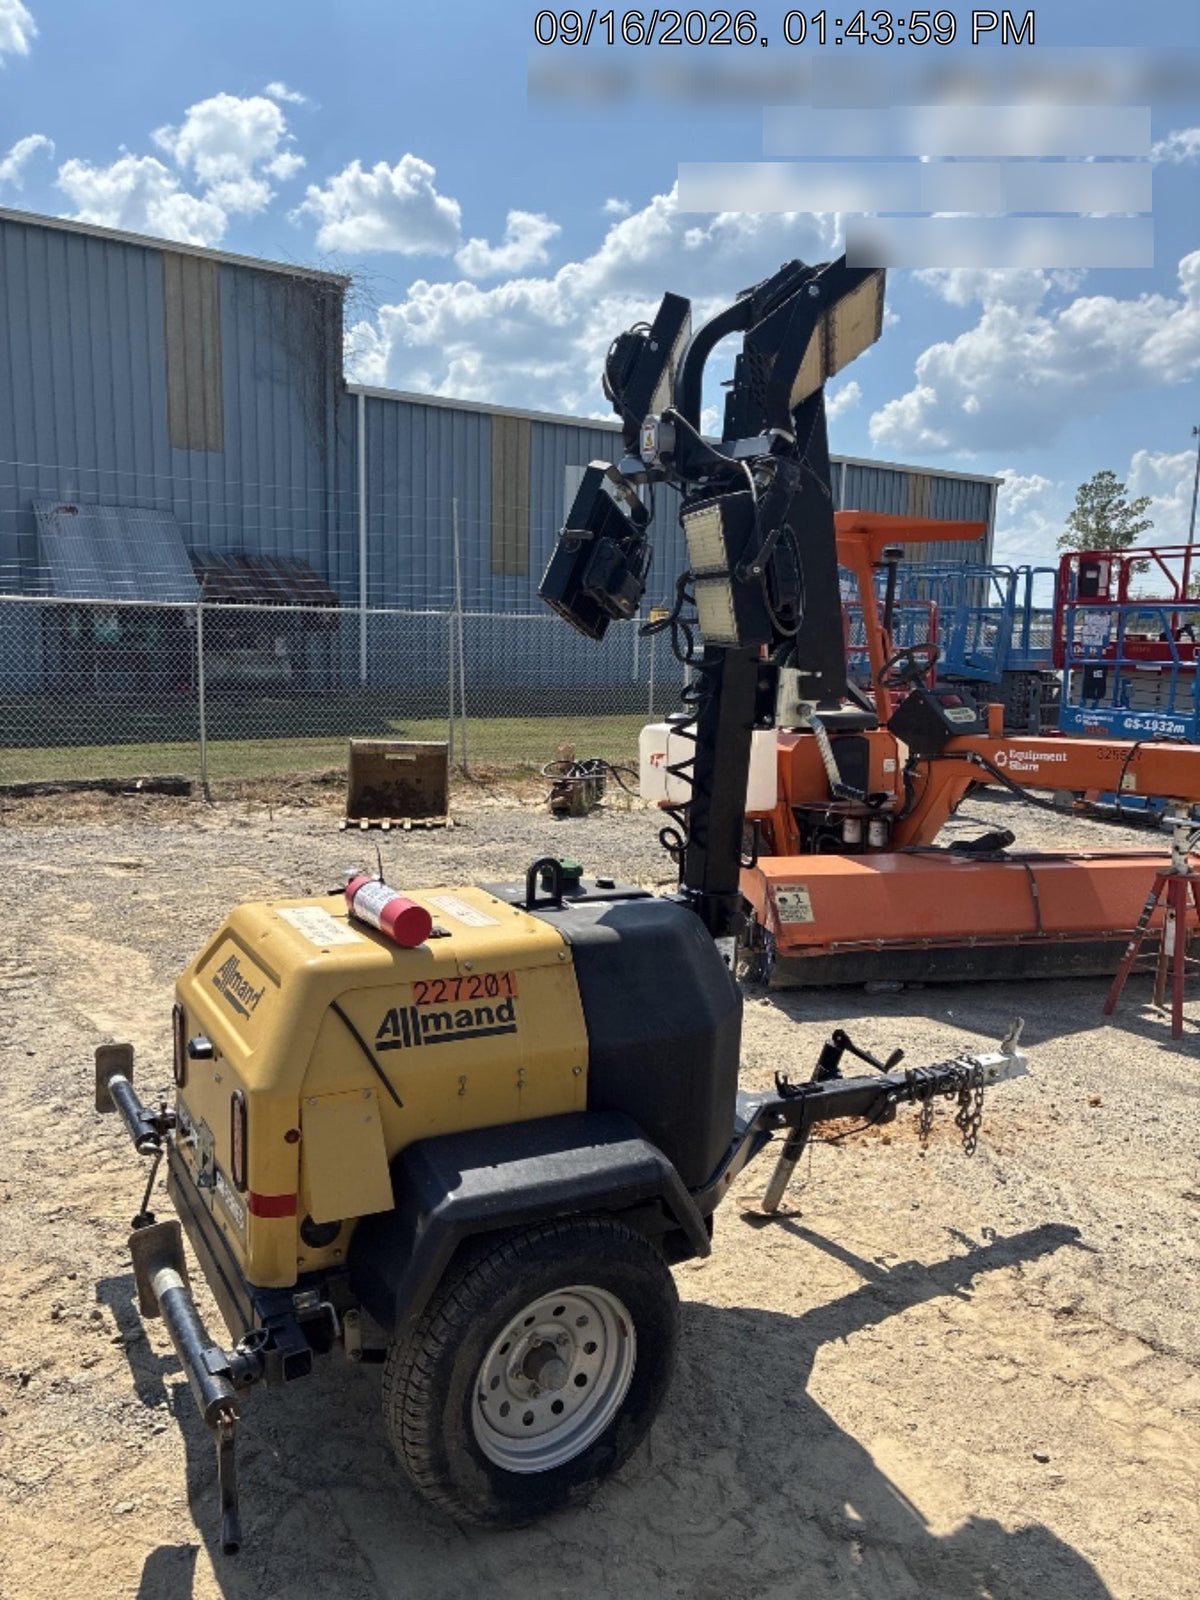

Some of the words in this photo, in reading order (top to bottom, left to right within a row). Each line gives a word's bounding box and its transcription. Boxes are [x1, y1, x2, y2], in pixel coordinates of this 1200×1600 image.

[1123, 718, 1185, 733] GS-1932m
[1009, 749, 1068, 762] Equipment
[1009, 760, 1040, 772] Share
[216, 954, 266, 1012] Allmand
[413, 972, 513, 1006] 227201
[375, 996, 516, 1048] Allmand
